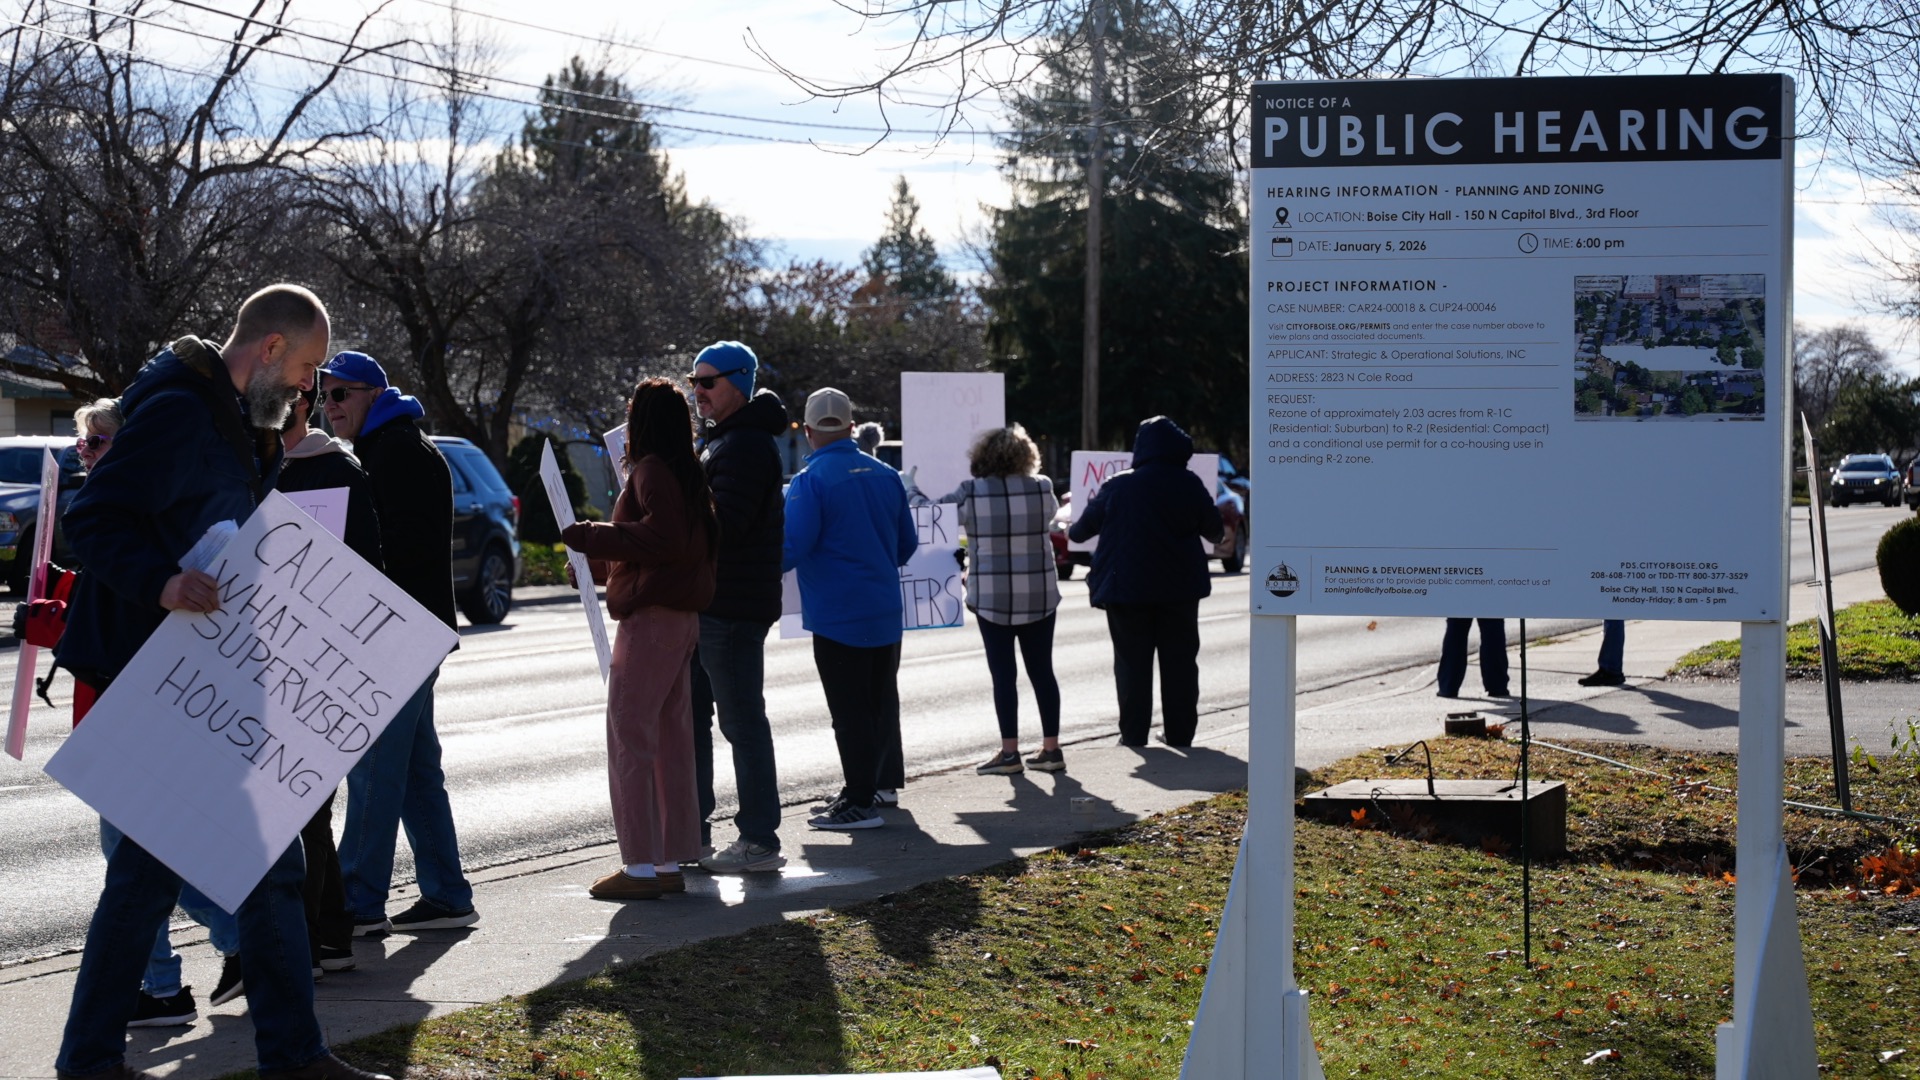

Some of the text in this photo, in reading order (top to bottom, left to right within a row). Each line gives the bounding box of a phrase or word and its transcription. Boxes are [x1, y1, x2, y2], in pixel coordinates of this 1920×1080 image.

[1265, 96, 1351, 109] NOTICE OF A
[1265, 106, 1769, 158] PUBLIC HEARING
[1267, 186, 1330, 198] HEARING
[1337, 184, 1437, 197] INFORMATION
[1455, 184, 1519, 196] PLANNING
[1522, 184, 1550, 195] AND
[1554, 183, 1604, 195] ZONING
[1298, 211, 1364, 222] LOCATION:
[1367, 210, 1398, 221] Boise
[1401, 210, 1425, 223] City
[1429, 209, 1451, 221] Hall
[1464, 209, 1485, 220] 150
[1488, 209, 1497, 220] N
[1501, 208, 1545, 222] Capitol
[1549, 207, 1582, 220] Blvd.,
[1585, 207, 1605, 219] 3rd
[1609, 207, 1639, 218] Floor
[1298, 240, 1426, 254] DATE: January 5, 2026
[1543, 237, 1624, 250] TIME: 6:00 pm
[1267, 280, 1329, 292] PROJECT
[1335, 279, 1435, 291] INFORMATION
[1267, 302, 1496, 313] CASE NUMBER: CAR24-00018 & CUP24-00046
[1285, 322, 1391, 331] CITYOFBOISE.ORG/PERMITS
[1411, 322, 1433, 330] enter
[1435, 322, 1448, 330] the
[1506, 321, 1534, 329] above
[1536, 321, 1545, 329] to
[1268, 332, 1287, 340] view
[1288, 332, 1310, 341] plans
[1330, 332, 1375, 340] associated
[1376, 332, 1425, 340] documents.
[1267, 349, 1526, 362] APPLICANT: Strategic & Operational Solutions, INC
[1267, 372, 1412, 383] ADDRESS: 2823 N Cole Road
[1267, 394, 1315, 404] REQUEST:
[1268, 407, 1512, 420] Rezone of approximately 2.03 acres from R-1C
[1269, 423, 1549, 435] (Residential: Suburban) to R-2 (Residential: Compact)
[1268, 438, 1543, 450] and a conditional use permit for a co-housing use in
[1268, 453, 1373, 466] a pending R-2 zone.
[1083, 459, 1128, 487] NOT
[1325, 565, 1483, 575] PLANNING & DEVELOPMENT SERVICES
[1620, 561, 1718, 570] PDS.CITYOFBOISE.ORG
[1324, 575, 1336, 583] For
[1337, 576, 1374, 585] questions
[1396, 576, 1426, 585] provide
[1428, 577, 1453, 586] public
[1454, 577, 1495, 586] comment,
[1497, 577, 1530, 586] contact
[1590, 571, 1646, 579] 208-608-7100
[1658, 571, 1690, 579] TDD-TTY
[1692, 572, 1748, 580] 800-377-3529
[255, 522, 352, 619] CALL
[340, 593, 407, 645] IT
[1600, 585, 1621, 593] Boise
[1623, 585, 1639, 594] City
[1685, 586, 1715, 595] Capitol
[1324, 585, 1427, 596] zoninginfo@cityofboise.org
[1712, 597, 1726, 605] pm
[215, 559, 392, 717] WHAT IT IS
[191, 608, 371, 753] SUPERVISED
[155, 656, 323, 798] HOUSING
